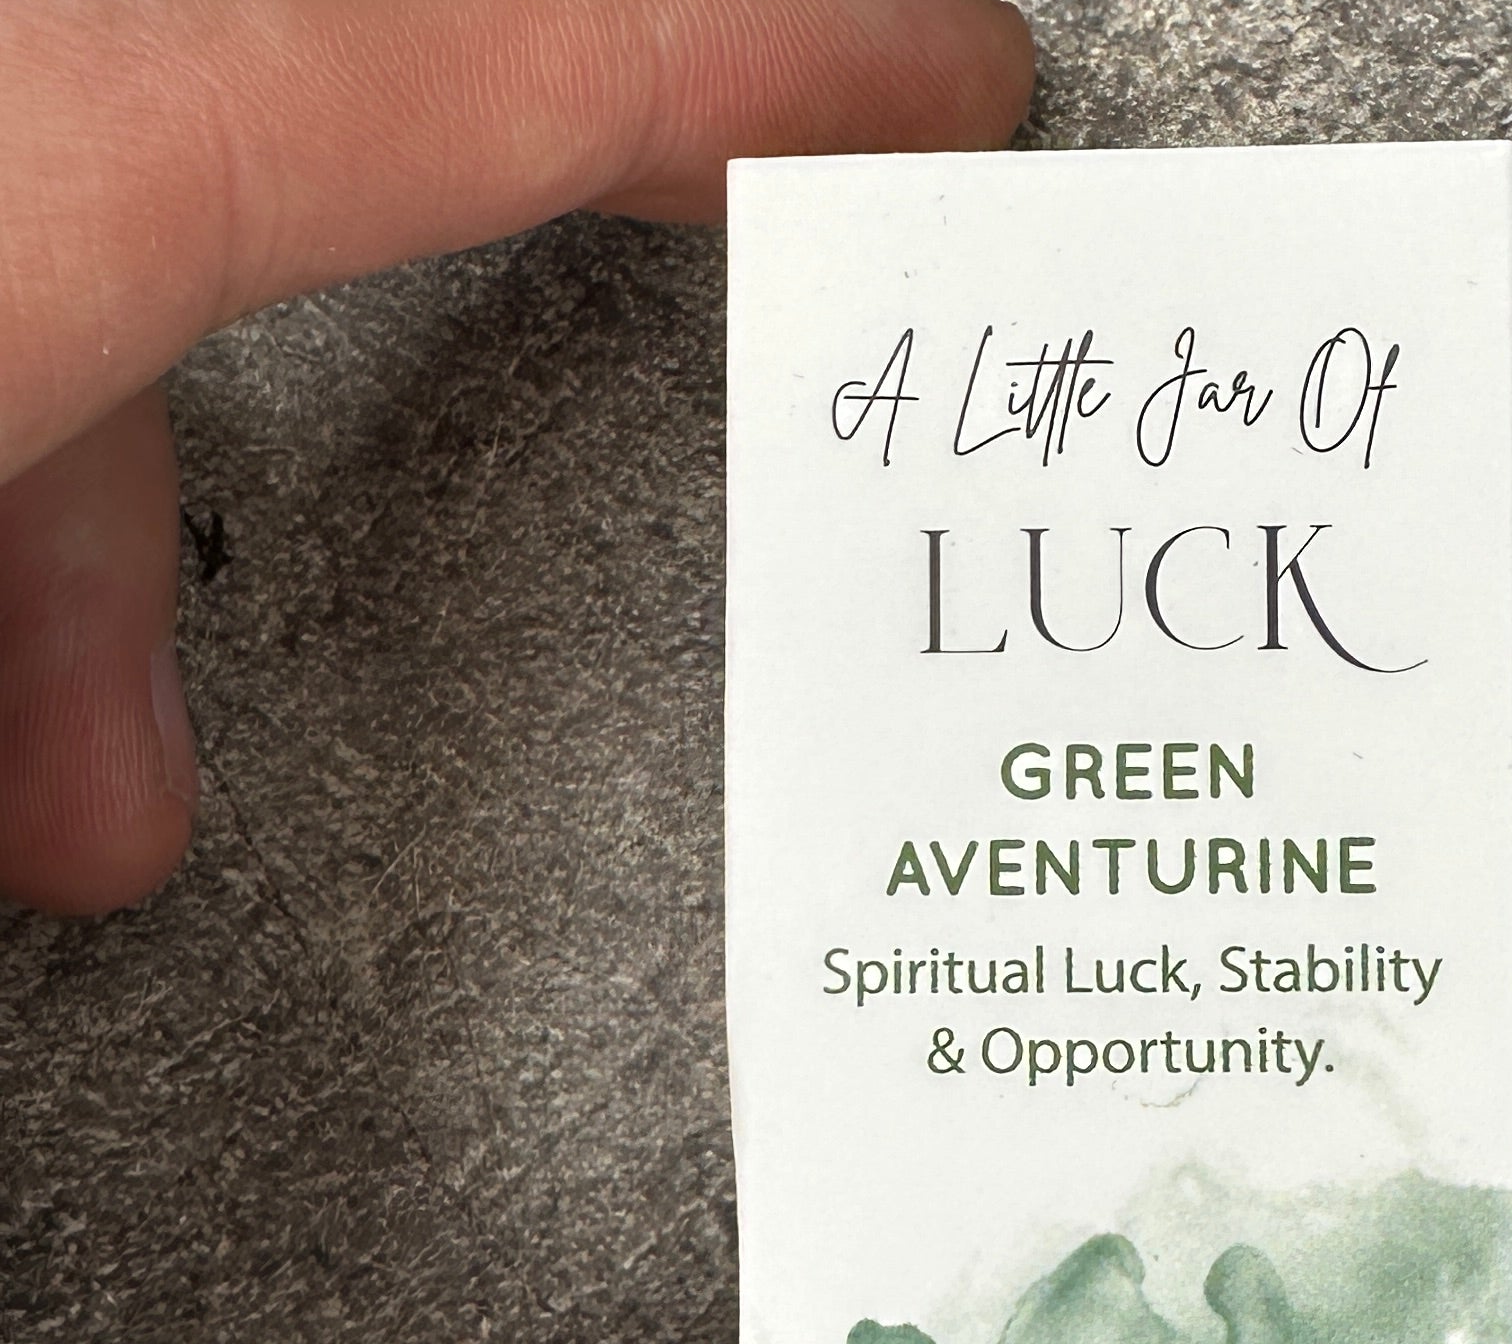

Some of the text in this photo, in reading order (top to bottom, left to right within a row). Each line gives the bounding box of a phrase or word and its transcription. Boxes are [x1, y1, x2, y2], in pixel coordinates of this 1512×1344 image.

[831, 324, 1401, 470] A Little Jar Of
[919, 523, 1429, 674] LUCK
[1000, 742, 1254, 801] GREEN
[885, 836, 1377, 897] AVENTURINE
[822, 942, 1444, 1008] Spiritual Luck, Stability
[926, 1026, 1335, 1088] & Opportunity.
